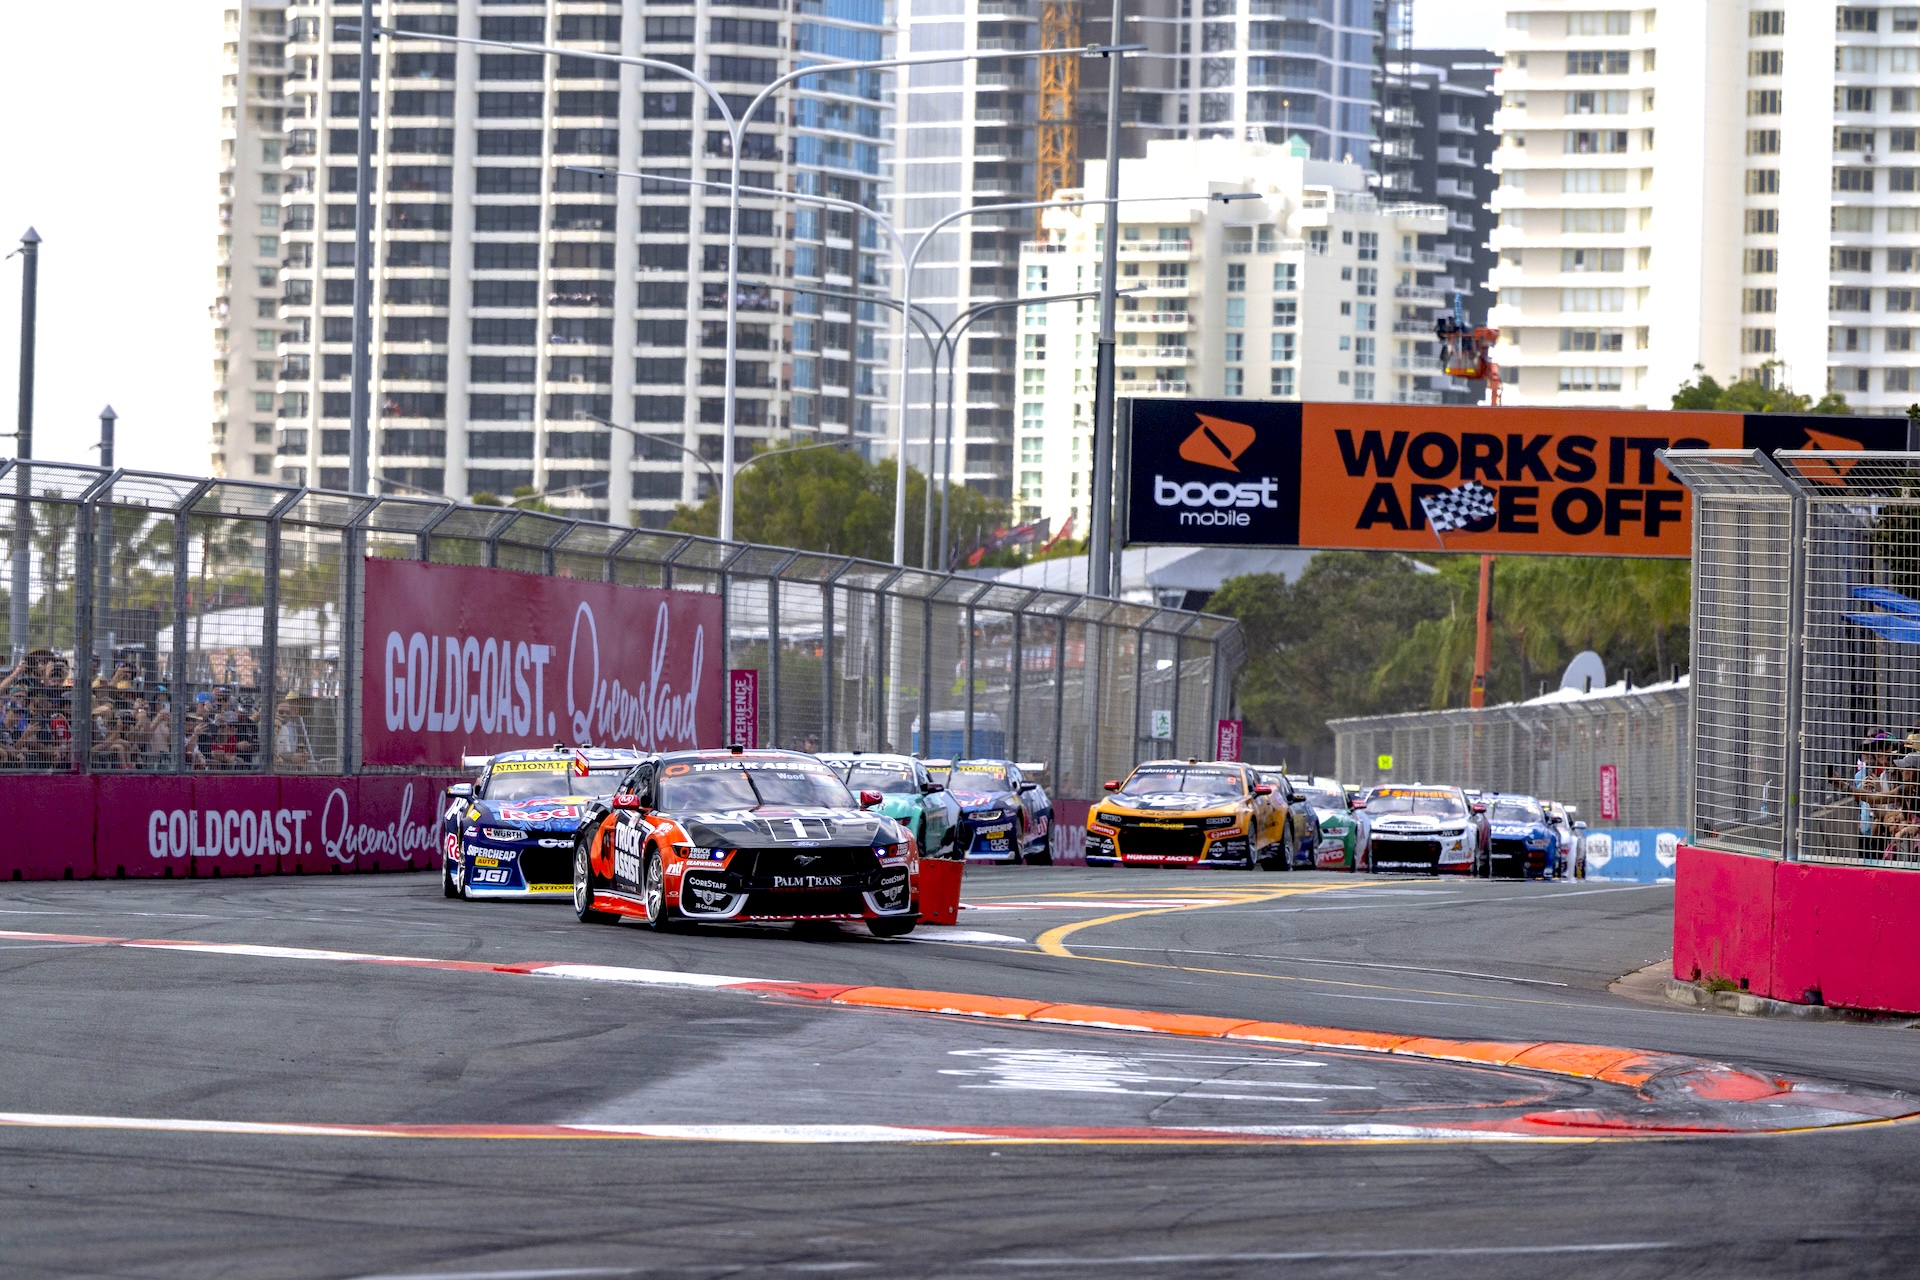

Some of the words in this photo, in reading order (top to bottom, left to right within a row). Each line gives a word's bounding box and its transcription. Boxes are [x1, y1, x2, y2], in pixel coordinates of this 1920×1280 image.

[1335, 429, 1598, 483] WORKS
[1154, 475, 1278, 508] boost
[1355, 482, 1539, 533] ARE
[1551, 488, 1683, 537] OFF
[1180, 510, 1250, 526] mobile
[567, 601, 703, 752] Queensland
[735, 679, 747, 749] PERIENCE
[496, 762, 564, 772] NATIONAL
[693, 763, 759, 771] TRUCK
[762, 762, 826, 773] ASSIST
[828, 759, 905, 771] AYCO
[502, 807, 576, 819] Red
[1206, 817, 1231, 825] SEIKO
[149, 808, 312, 858] GOLDCOAST.
[322, 783, 446, 863] Queensland
[616, 821, 641, 857] TRUCK
[466, 844, 516, 861] SUPERCHEAP
[477, 858, 496, 866] AUTO
[615, 849, 640, 885] ASSIST
[472, 868, 508, 883] JGI
[773, 876, 804, 888] PALM
[805, 876, 842, 888] TRANS
